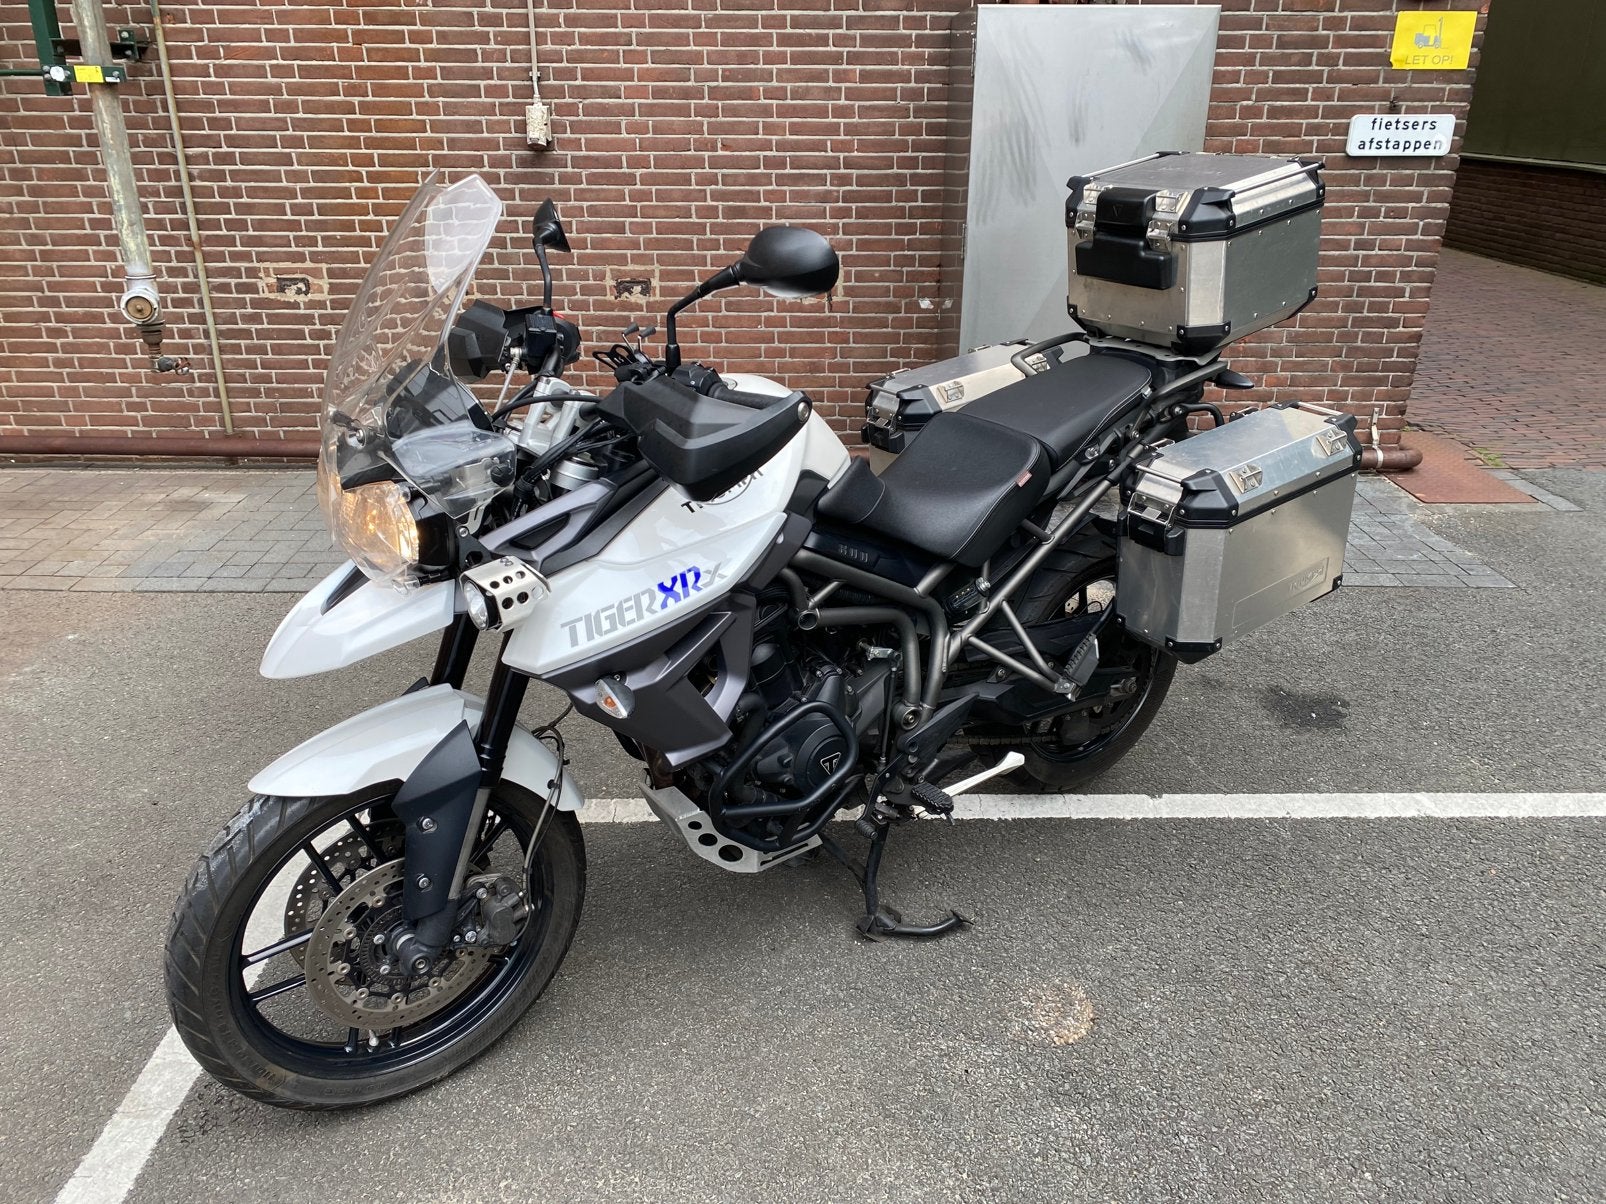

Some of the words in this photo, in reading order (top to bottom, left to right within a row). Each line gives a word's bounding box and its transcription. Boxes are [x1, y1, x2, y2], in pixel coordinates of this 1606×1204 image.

[1405, 55, 1428, 65] LET
[1432, 54, 1454, 65] OP!
[1371, 117, 1438, 131] fietsers
[1357, 137, 1444, 153] afstappen
